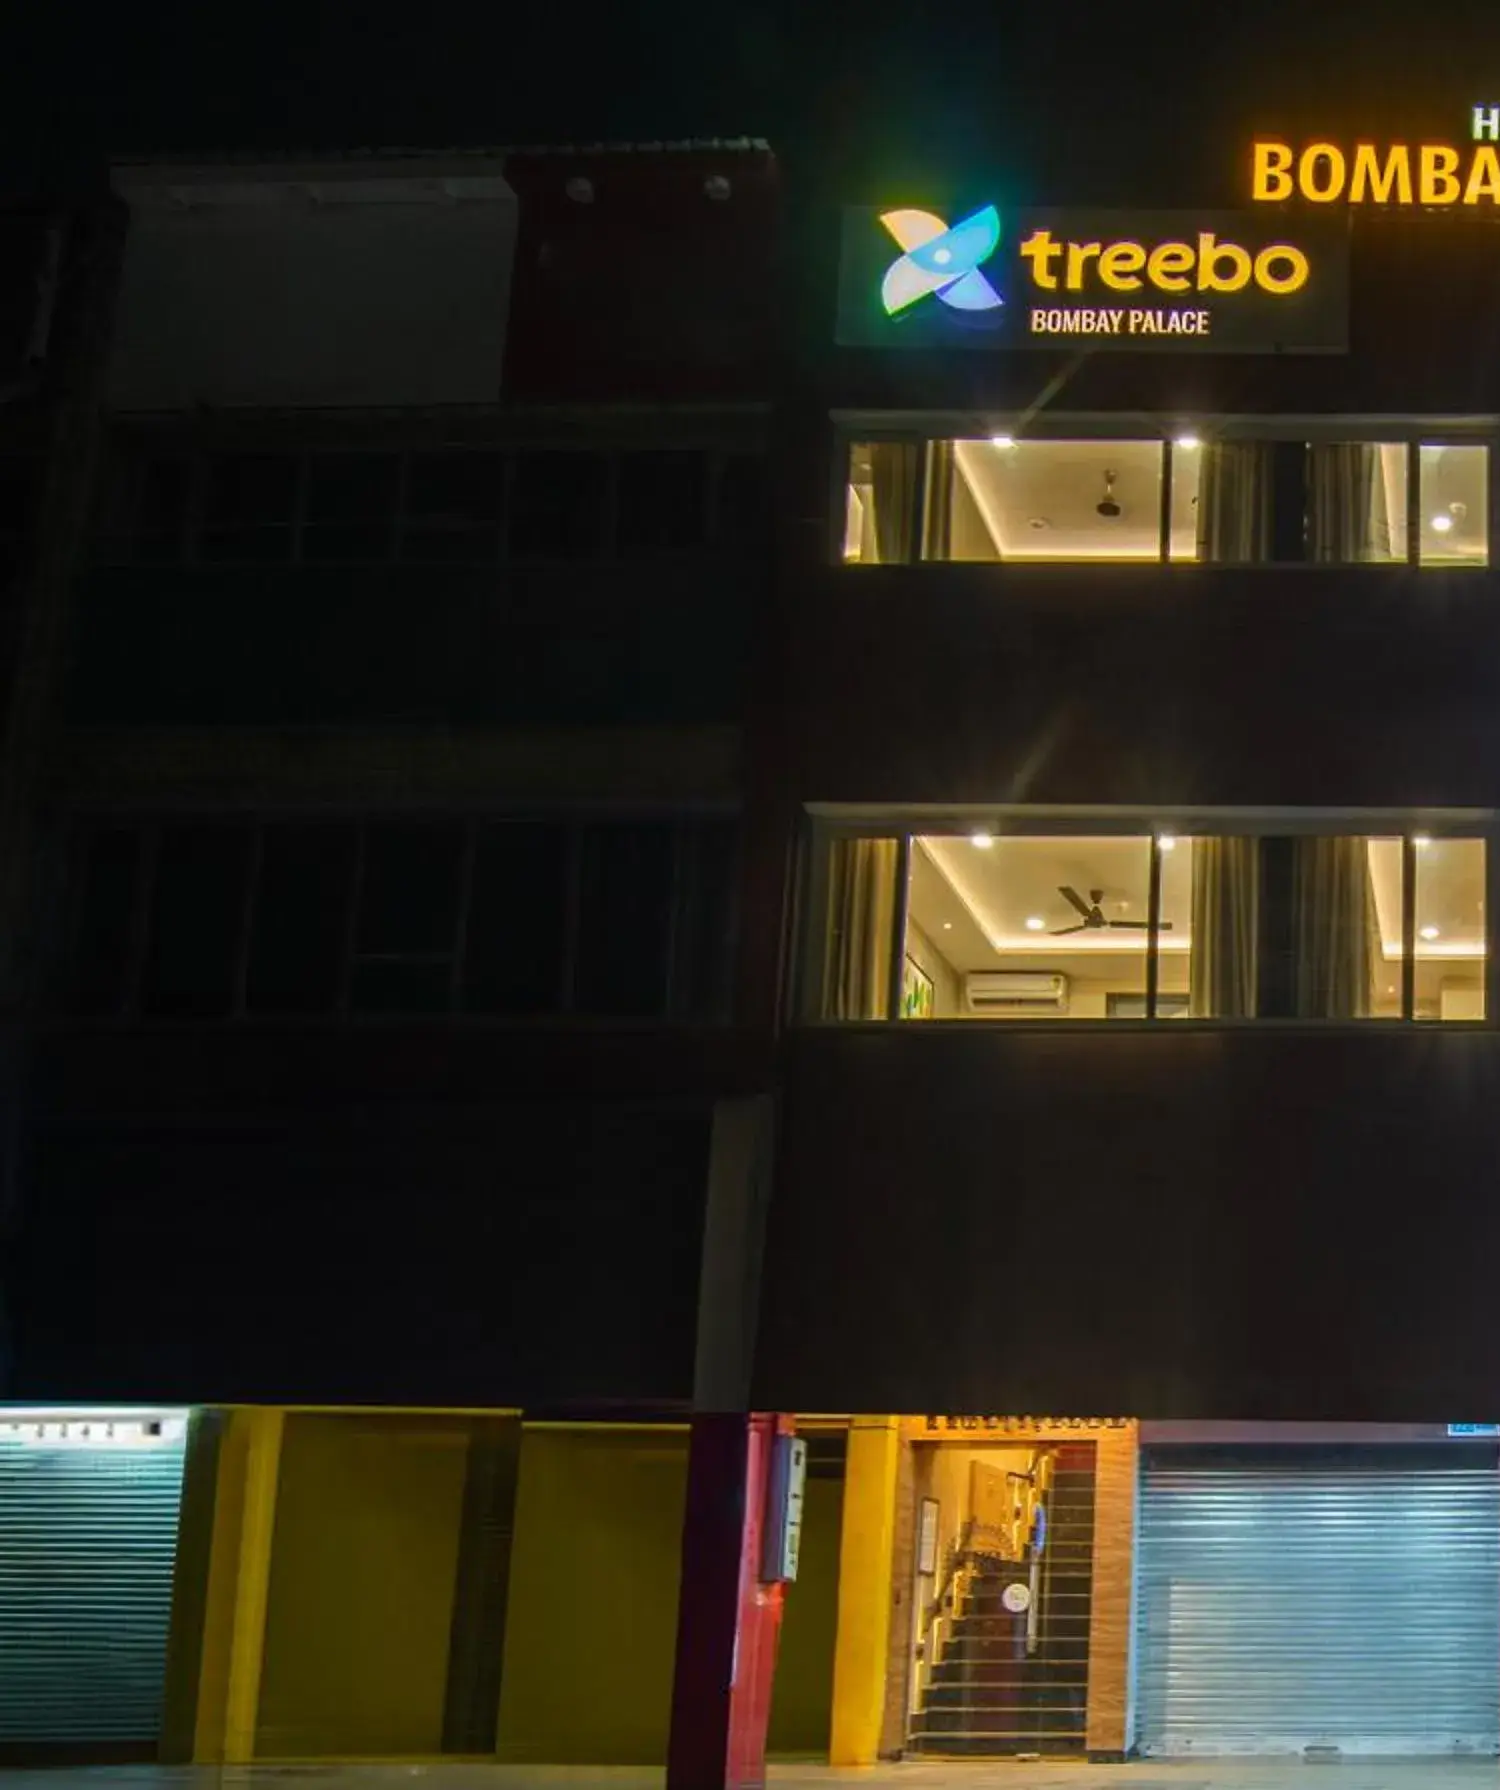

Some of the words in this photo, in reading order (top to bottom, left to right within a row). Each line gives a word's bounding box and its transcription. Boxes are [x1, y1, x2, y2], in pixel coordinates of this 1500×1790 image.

[1020, 231, 1309, 293] treebo
[1031, 308, 1122, 334] BOMBAY
[1129, 310, 1211, 335] PALACE
